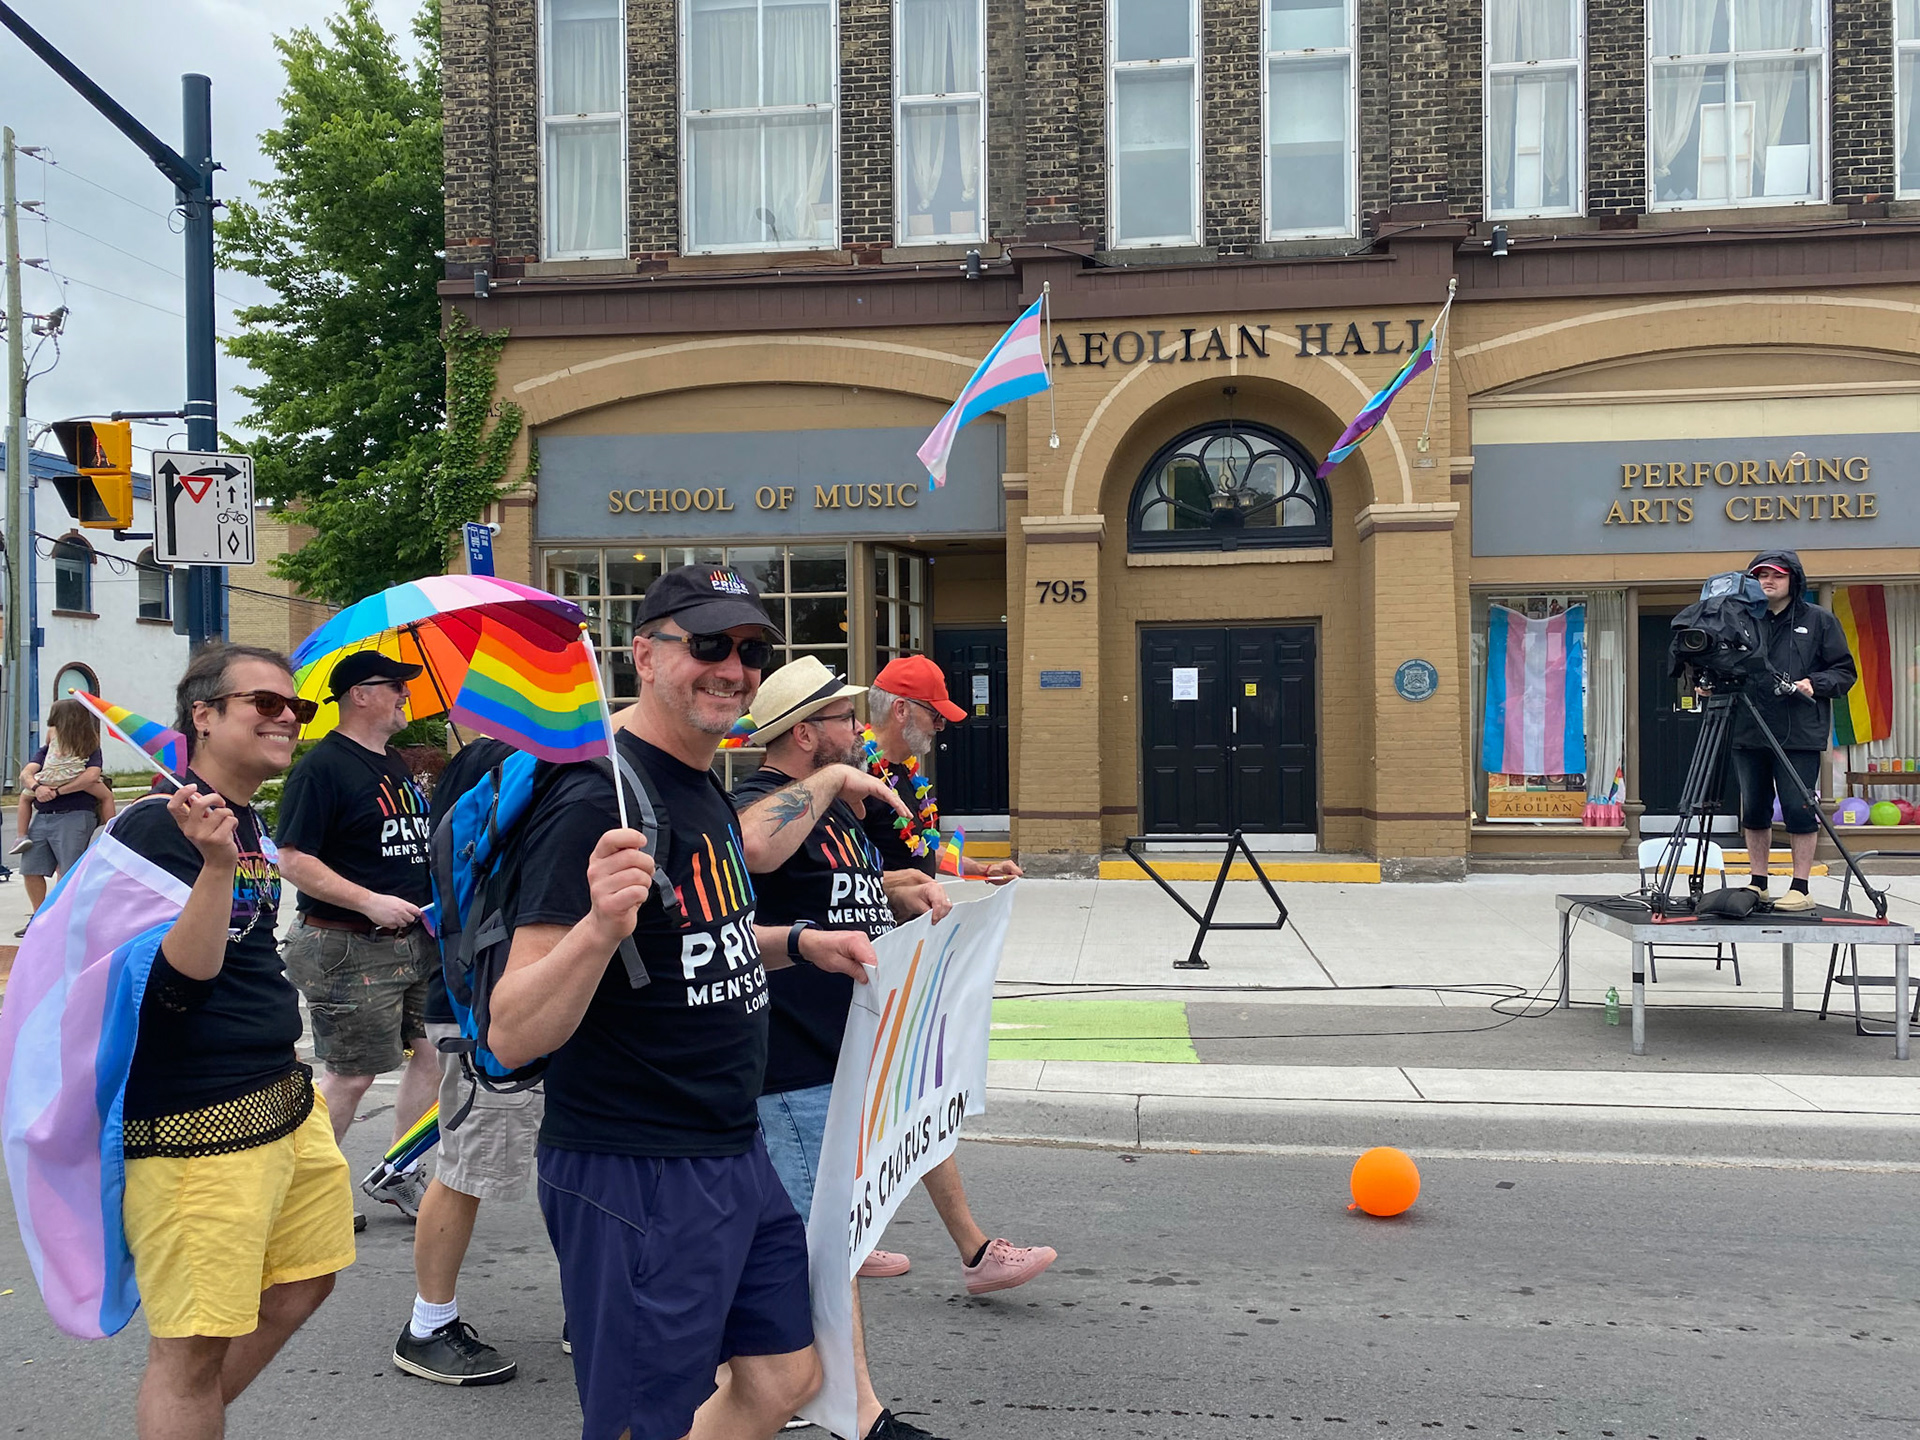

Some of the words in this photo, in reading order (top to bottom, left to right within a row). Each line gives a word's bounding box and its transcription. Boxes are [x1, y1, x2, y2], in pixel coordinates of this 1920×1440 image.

[1045, 324, 1271, 368] AEOLIAN
[1621, 457, 1871, 489] PERFORMING
[608, 487, 735, 513] SCHOOL
[755, 486, 795, 510] OF
[813, 483, 918, 508] MUSIC
[1604, 497, 1694, 525] ARTS
[1725, 492, 1879, 523] CENTRE
[1035, 580, 1087, 604] 795
[1503, 803, 1572, 812] AEOLIAN
[382, 844, 418, 857] MEN'S
[828, 908, 877, 924] MEN'S
[686, 972, 754, 1007] MEN'S
[878, 1115, 931, 1206] CHORUS
